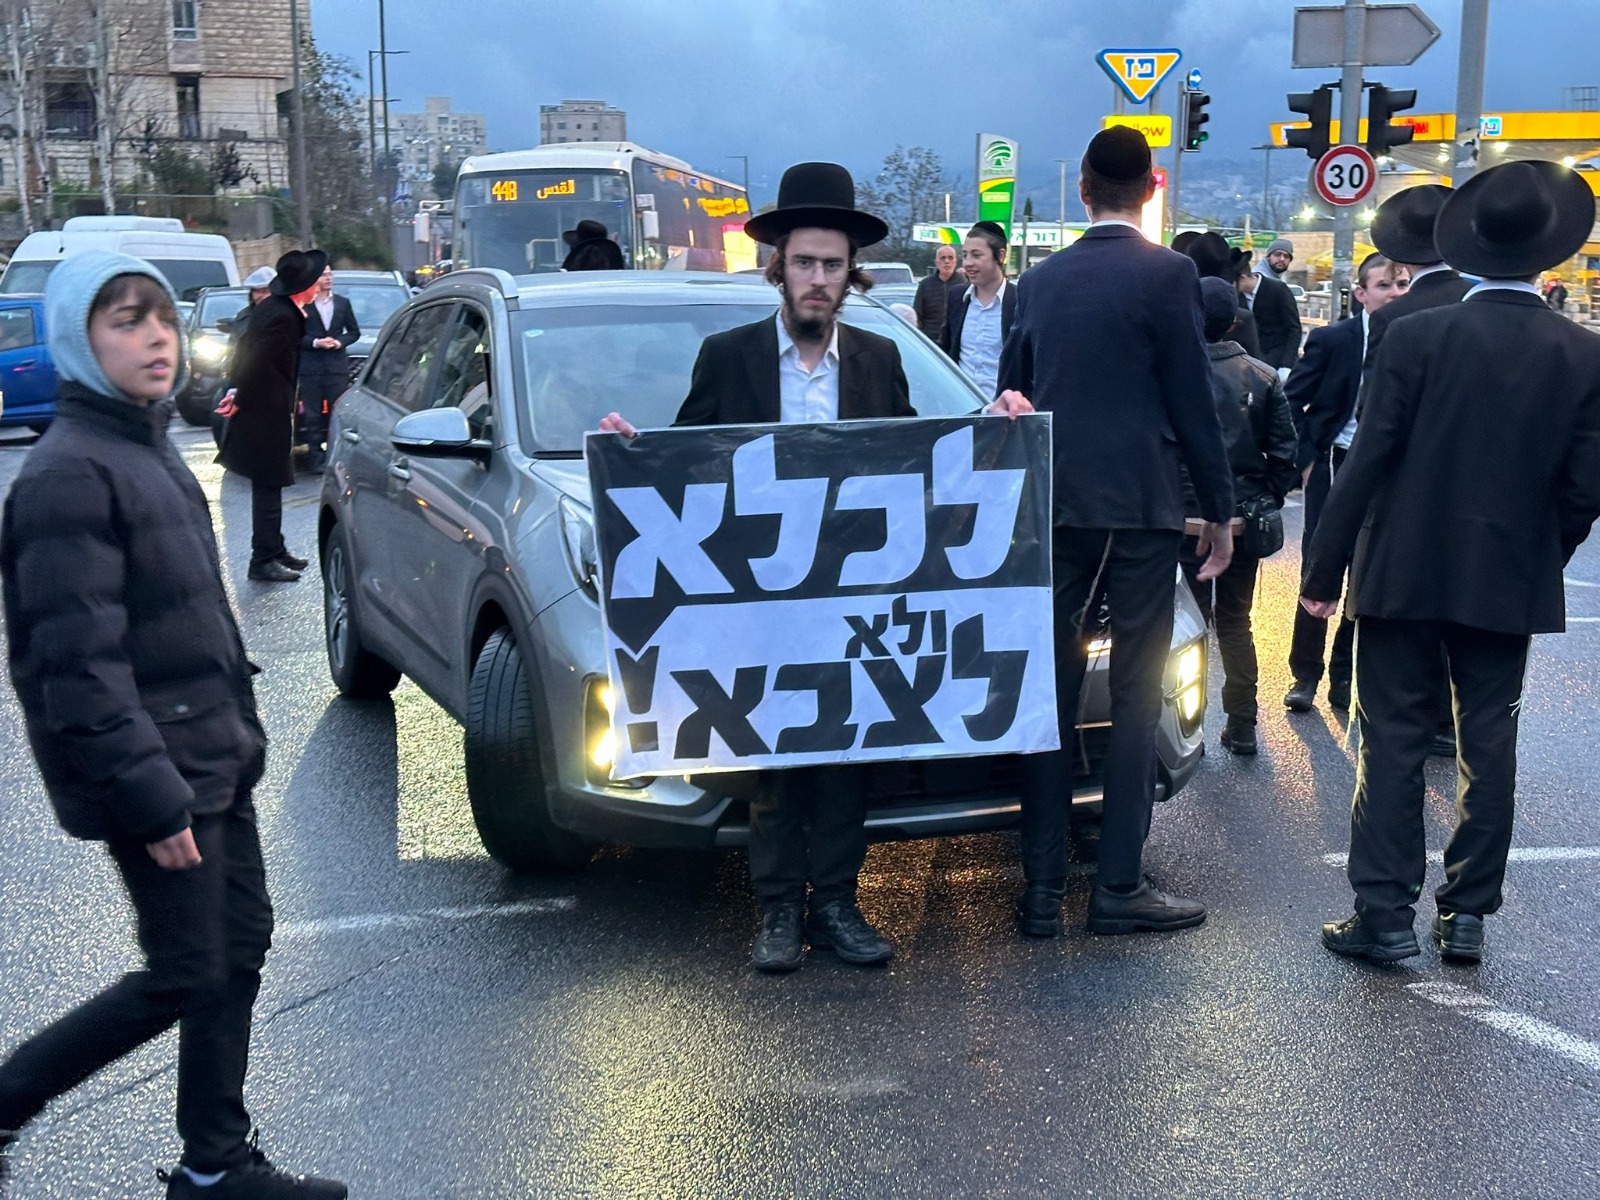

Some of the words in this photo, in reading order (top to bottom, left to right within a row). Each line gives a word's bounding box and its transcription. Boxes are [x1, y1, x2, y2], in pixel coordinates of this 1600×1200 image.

[1125, 58, 1155, 78] פז
[536, 179, 575, 199] القدس
[1328, 163, 1364, 189] 30
[606, 425, 1026, 599] לכלא
[843, 594, 947, 659] ולא
[615, 613, 1029, 759] לצבא!
